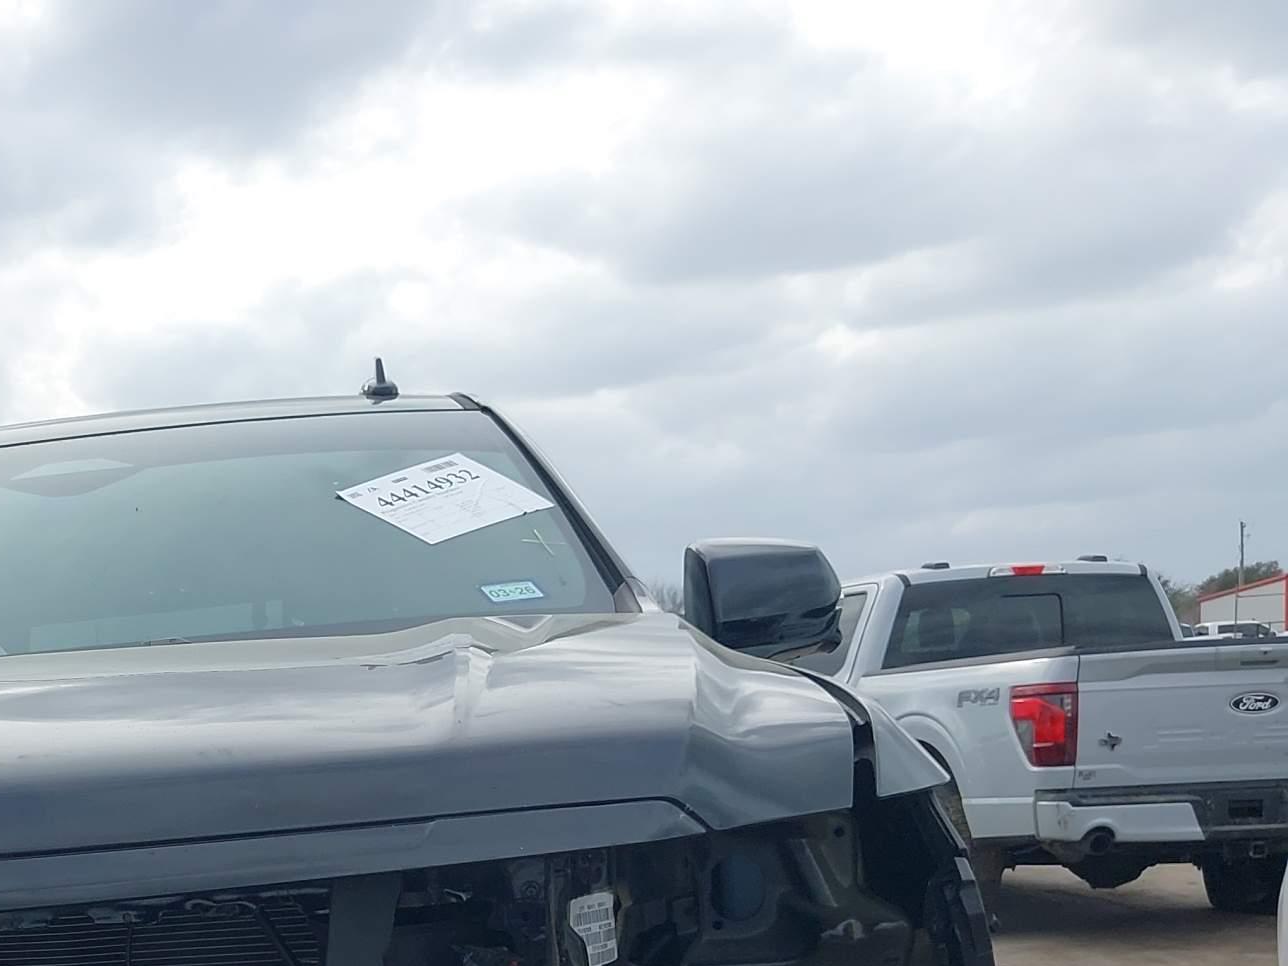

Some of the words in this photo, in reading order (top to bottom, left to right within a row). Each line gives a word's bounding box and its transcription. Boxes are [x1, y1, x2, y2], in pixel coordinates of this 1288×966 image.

[377, 469, 480, 508] 44414932
[956, 687, 1000, 708] FX4
[1239, 695, 1272, 710] Ford
